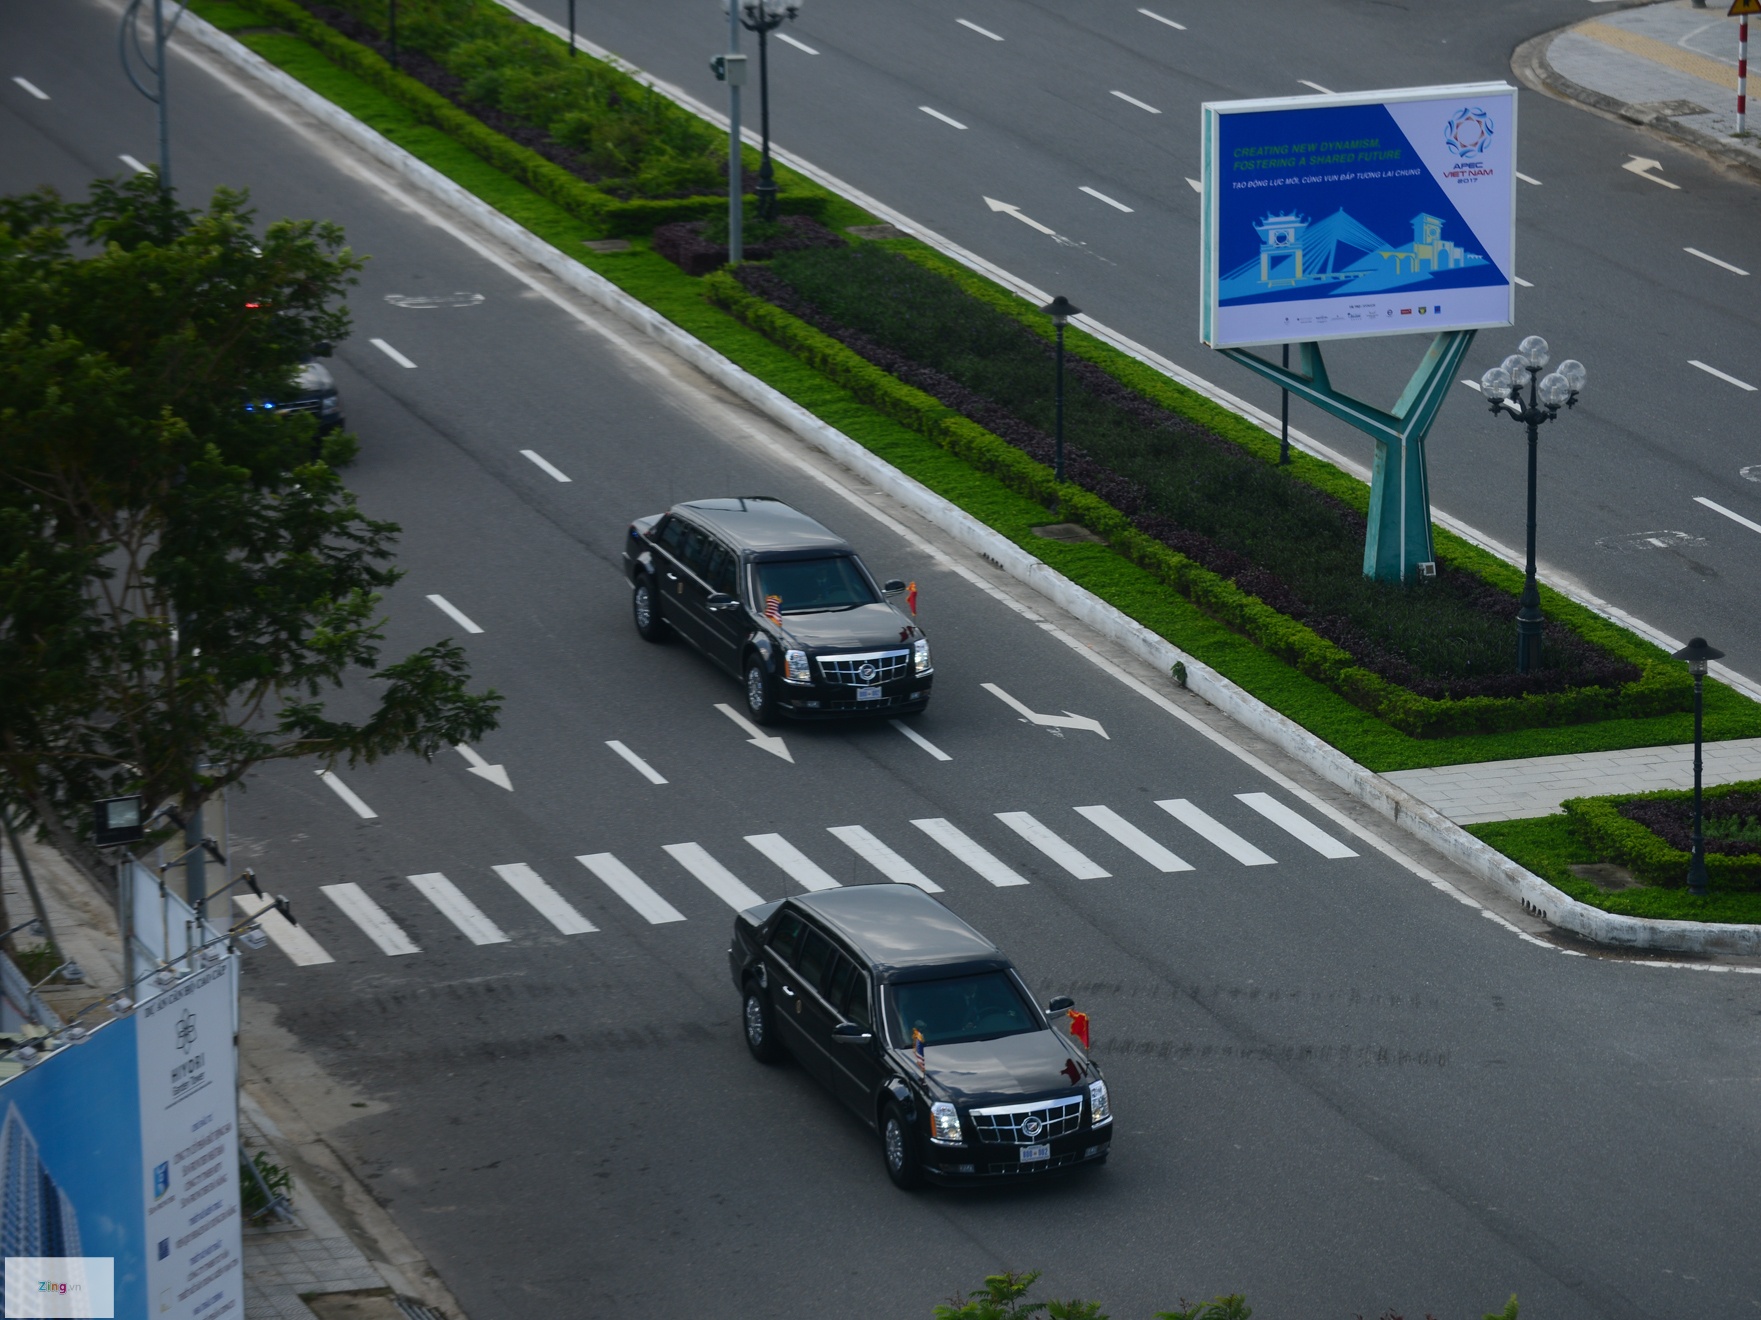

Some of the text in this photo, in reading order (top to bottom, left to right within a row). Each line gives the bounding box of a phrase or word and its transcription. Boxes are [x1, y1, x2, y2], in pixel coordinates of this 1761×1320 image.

[1233, 138, 1381, 158] CREATING NEW DYNAMISM,
[1233, 149, 1402, 171] FOSTERING A SHARED FUTURE
[1453, 162, 1484, 170] APEC
[1232, 181, 1247, 190] TẠO
[1302, 174, 1322, 184] CÙNG
[1323, 173, 1339, 182] VUN
[1382, 170, 1395, 178] LAI
[1395, 168, 1421, 177] CHUNG
[1443, 170, 1467, 178] VIET
[171, 1052, 206, 1084] HIYORI
